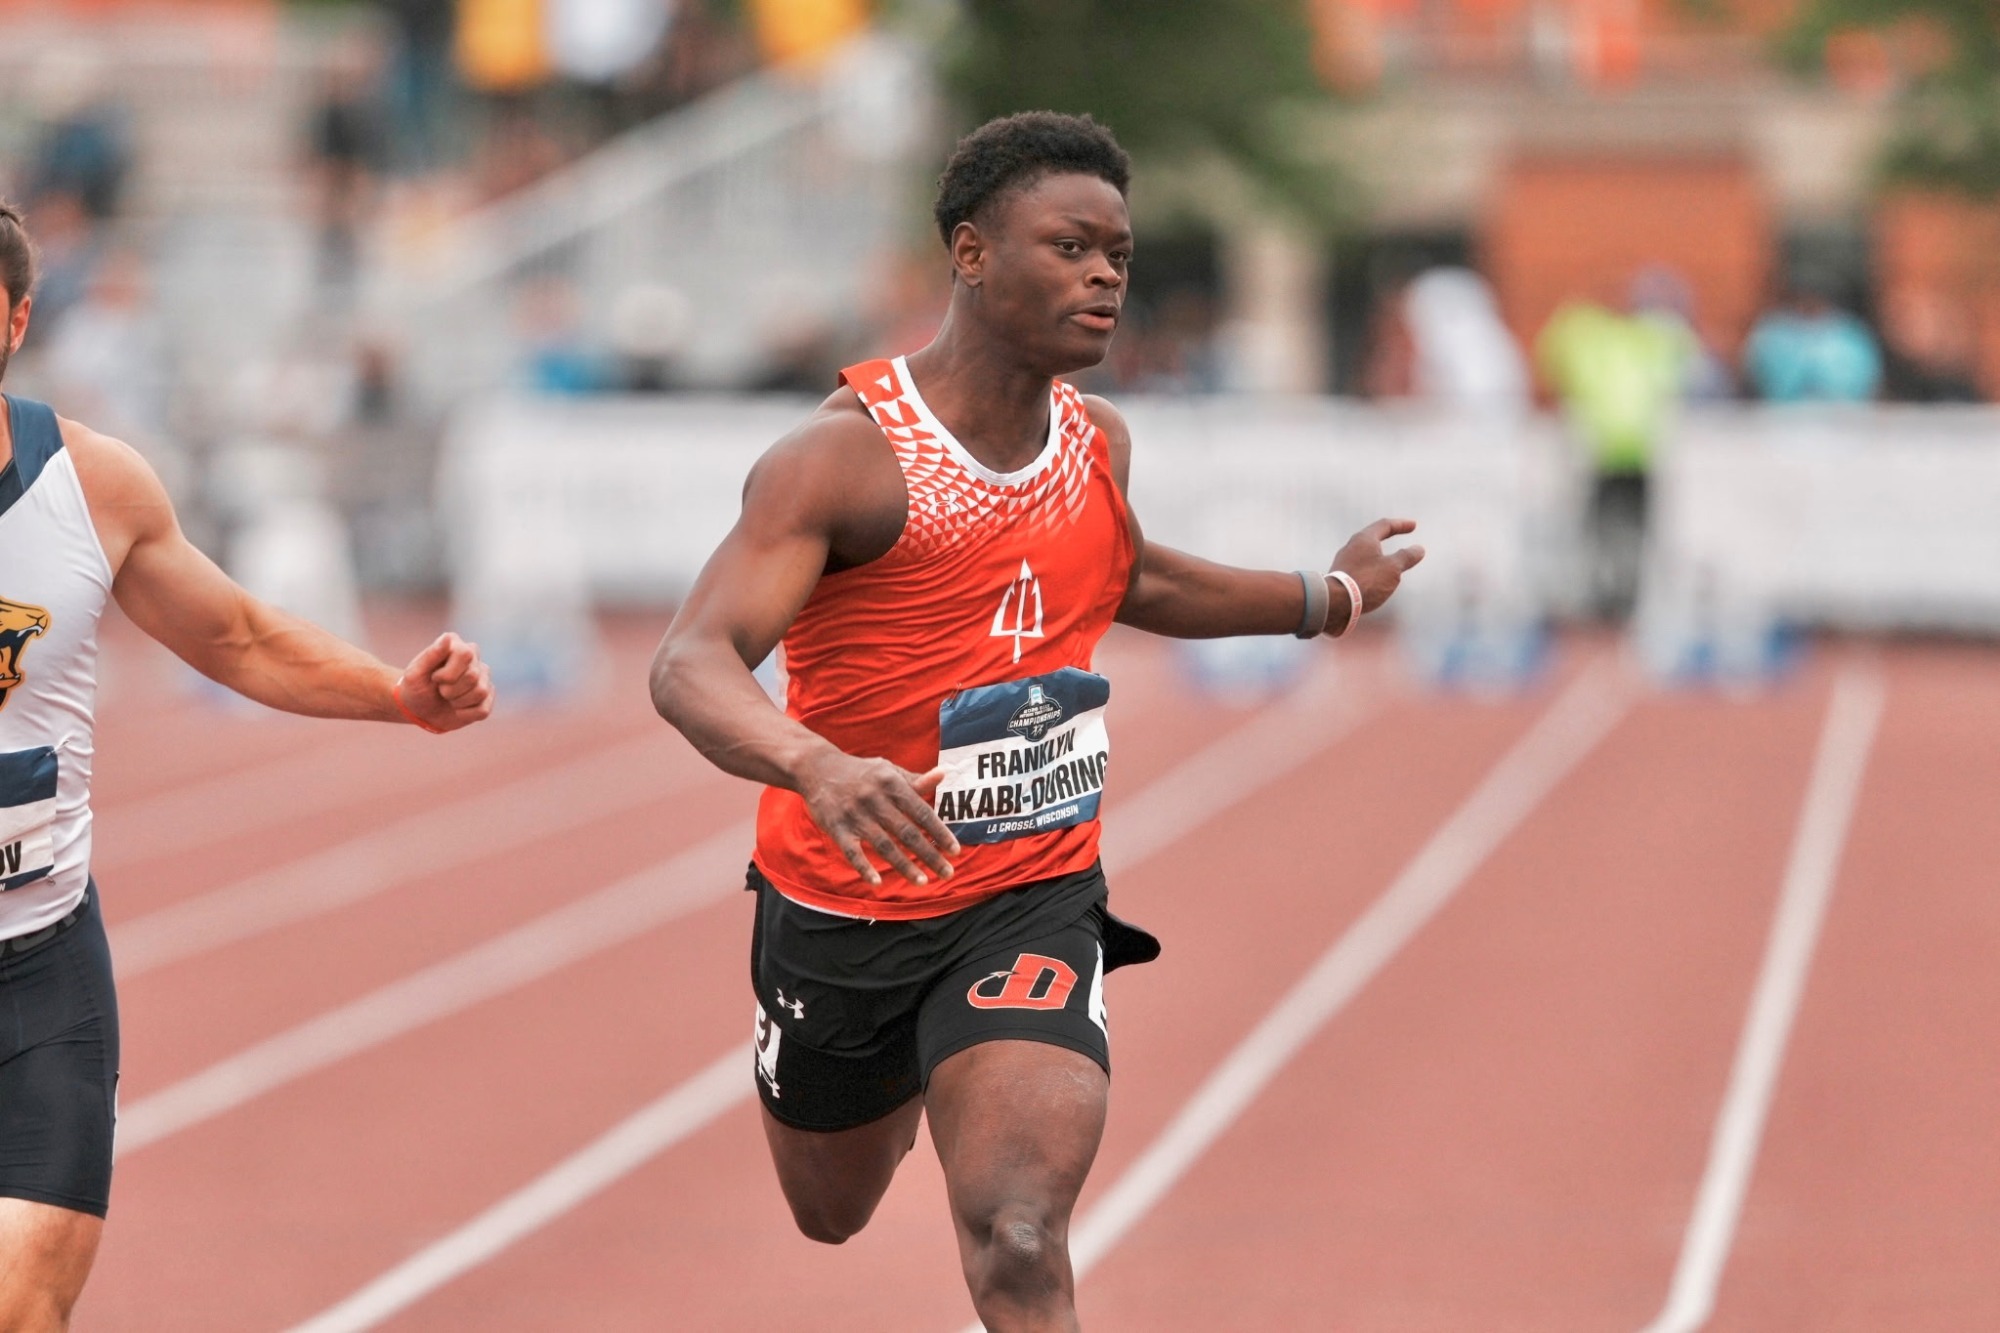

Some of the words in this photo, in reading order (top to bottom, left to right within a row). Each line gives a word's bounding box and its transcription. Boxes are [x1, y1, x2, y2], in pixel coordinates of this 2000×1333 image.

[1009, 709, 1061, 728] CHAMPIONSHIPS
[977, 727, 1075, 779] FRANKLYN
[987, 824, 997, 833] LA
[999, 819, 1035, 832] CROSSE,
[1036, 804, 1079, 827] WISCONSIN
